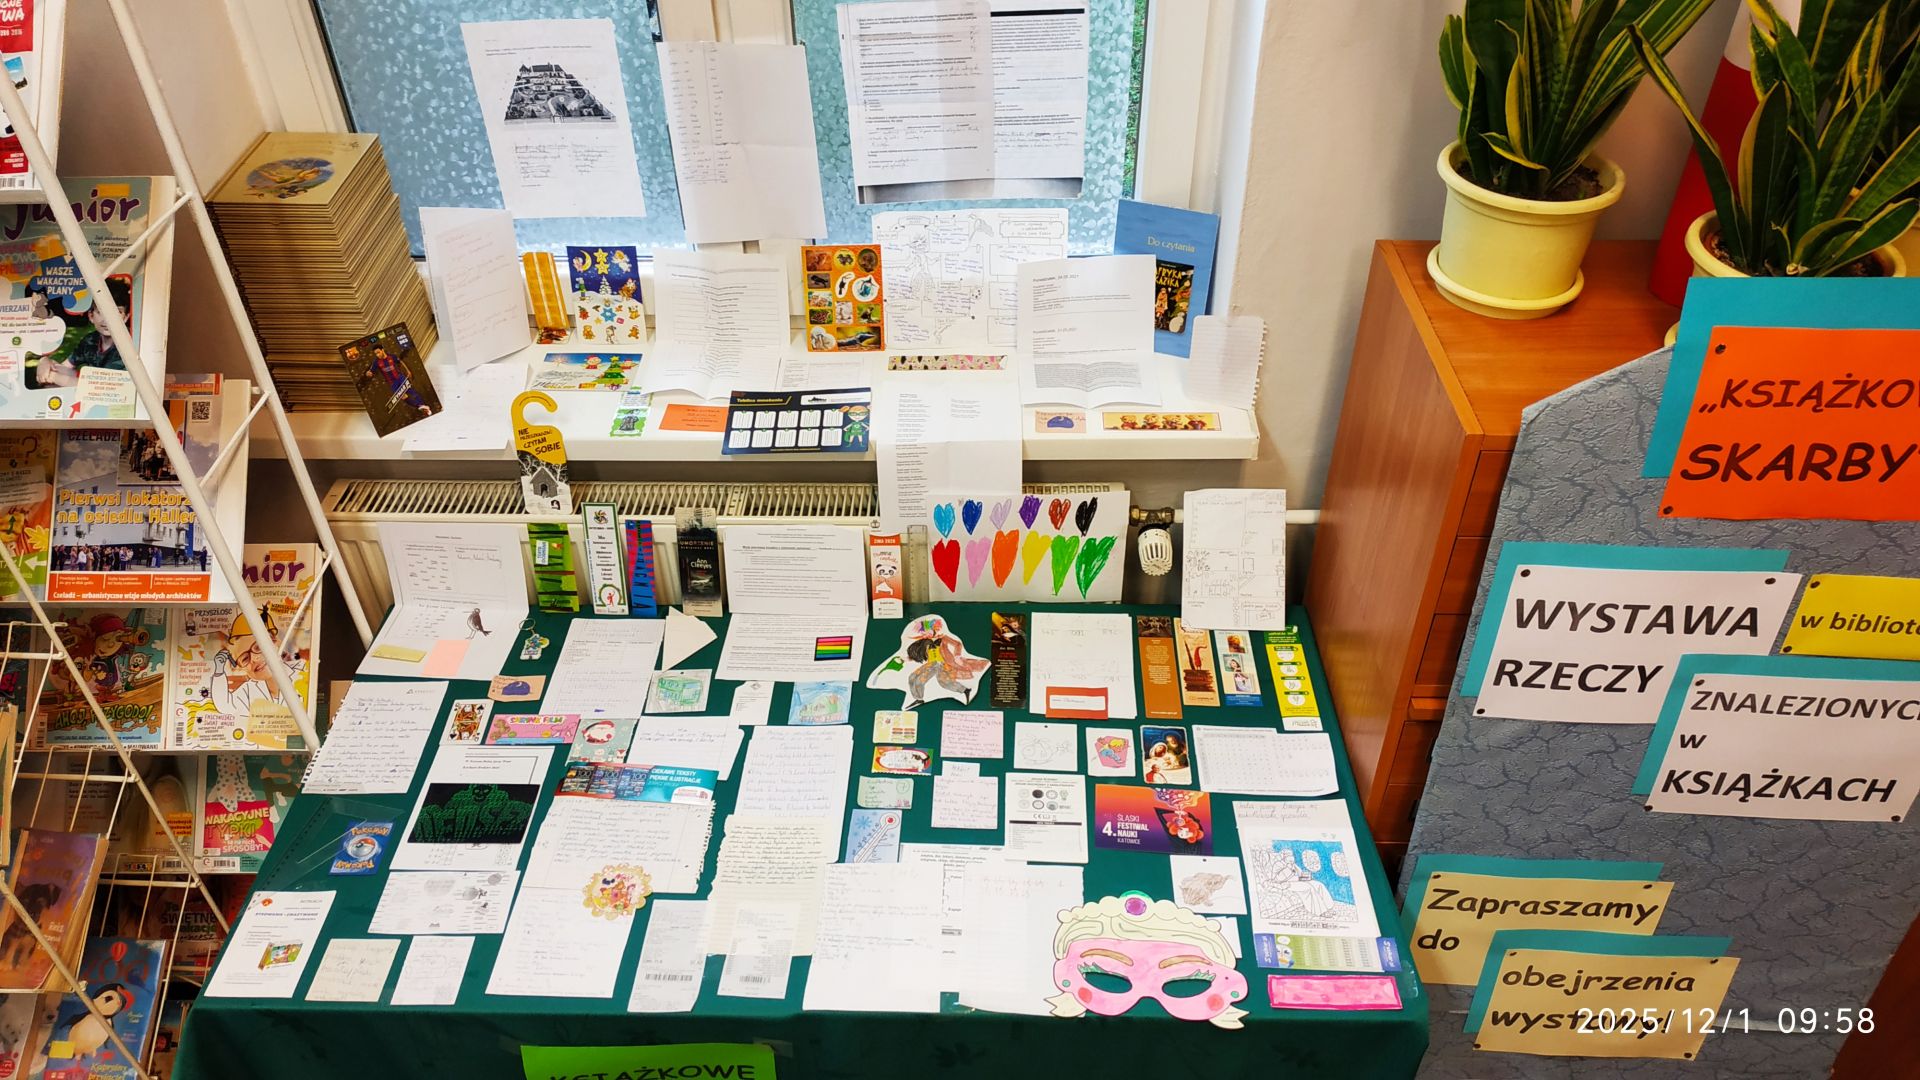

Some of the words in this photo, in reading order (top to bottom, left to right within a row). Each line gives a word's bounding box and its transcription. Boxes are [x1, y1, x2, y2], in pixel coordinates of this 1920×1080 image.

[1147, 236, 1161, 246] Do
[46, 266, 73, 275] WASZE
[36, 277, 84, 286] WAKACYJNE
[47, 287, 74, 295] PLANY
[1700, 373, 1920, 414] „KSIĄŻKO
[524, 437, 547, 449] CZYTAM
[535, 442, 561, 455] SOBIE
[1680, 443, 1920, 483] SKARBY
[60, 489, 121, 506] Pierwsi
[126, 489, 192, 506] lokatorz
[57, 511, 79, 524] na
[84, 507, 143, 524] osiedlu
[149, 507, 196, 524] Haller
[242, 554, 304, 583] nior
[1515, 598, 1759, 637] WYSTAWA
[1800, 614, 1824, 630] w
[1492, 659, 1663, 694] RZECZY
[1690, 689, 1920, 722] ZNALEZIONYC
[54, 709, 87, 729] AHOJ,
[90, 704, 154, 724] PZYGODO!
[1678, 733, 1707, 750] w
[1661, 768, 1897, 804] KSIĄŻKACH
[205, 807, 270, 825] WAKACYJNE
[1117, 822, 1149, 831] FESTIWAL
[1117, 830, 1138, 838] NAUKI
[222, 843, 264, 852] SPOSOBY!
[1427, 888, 1660, 926] Zapraszamy
[1417, 929, 1461, 951] do
[1502, 965, 1696, 996] obejrzenia
